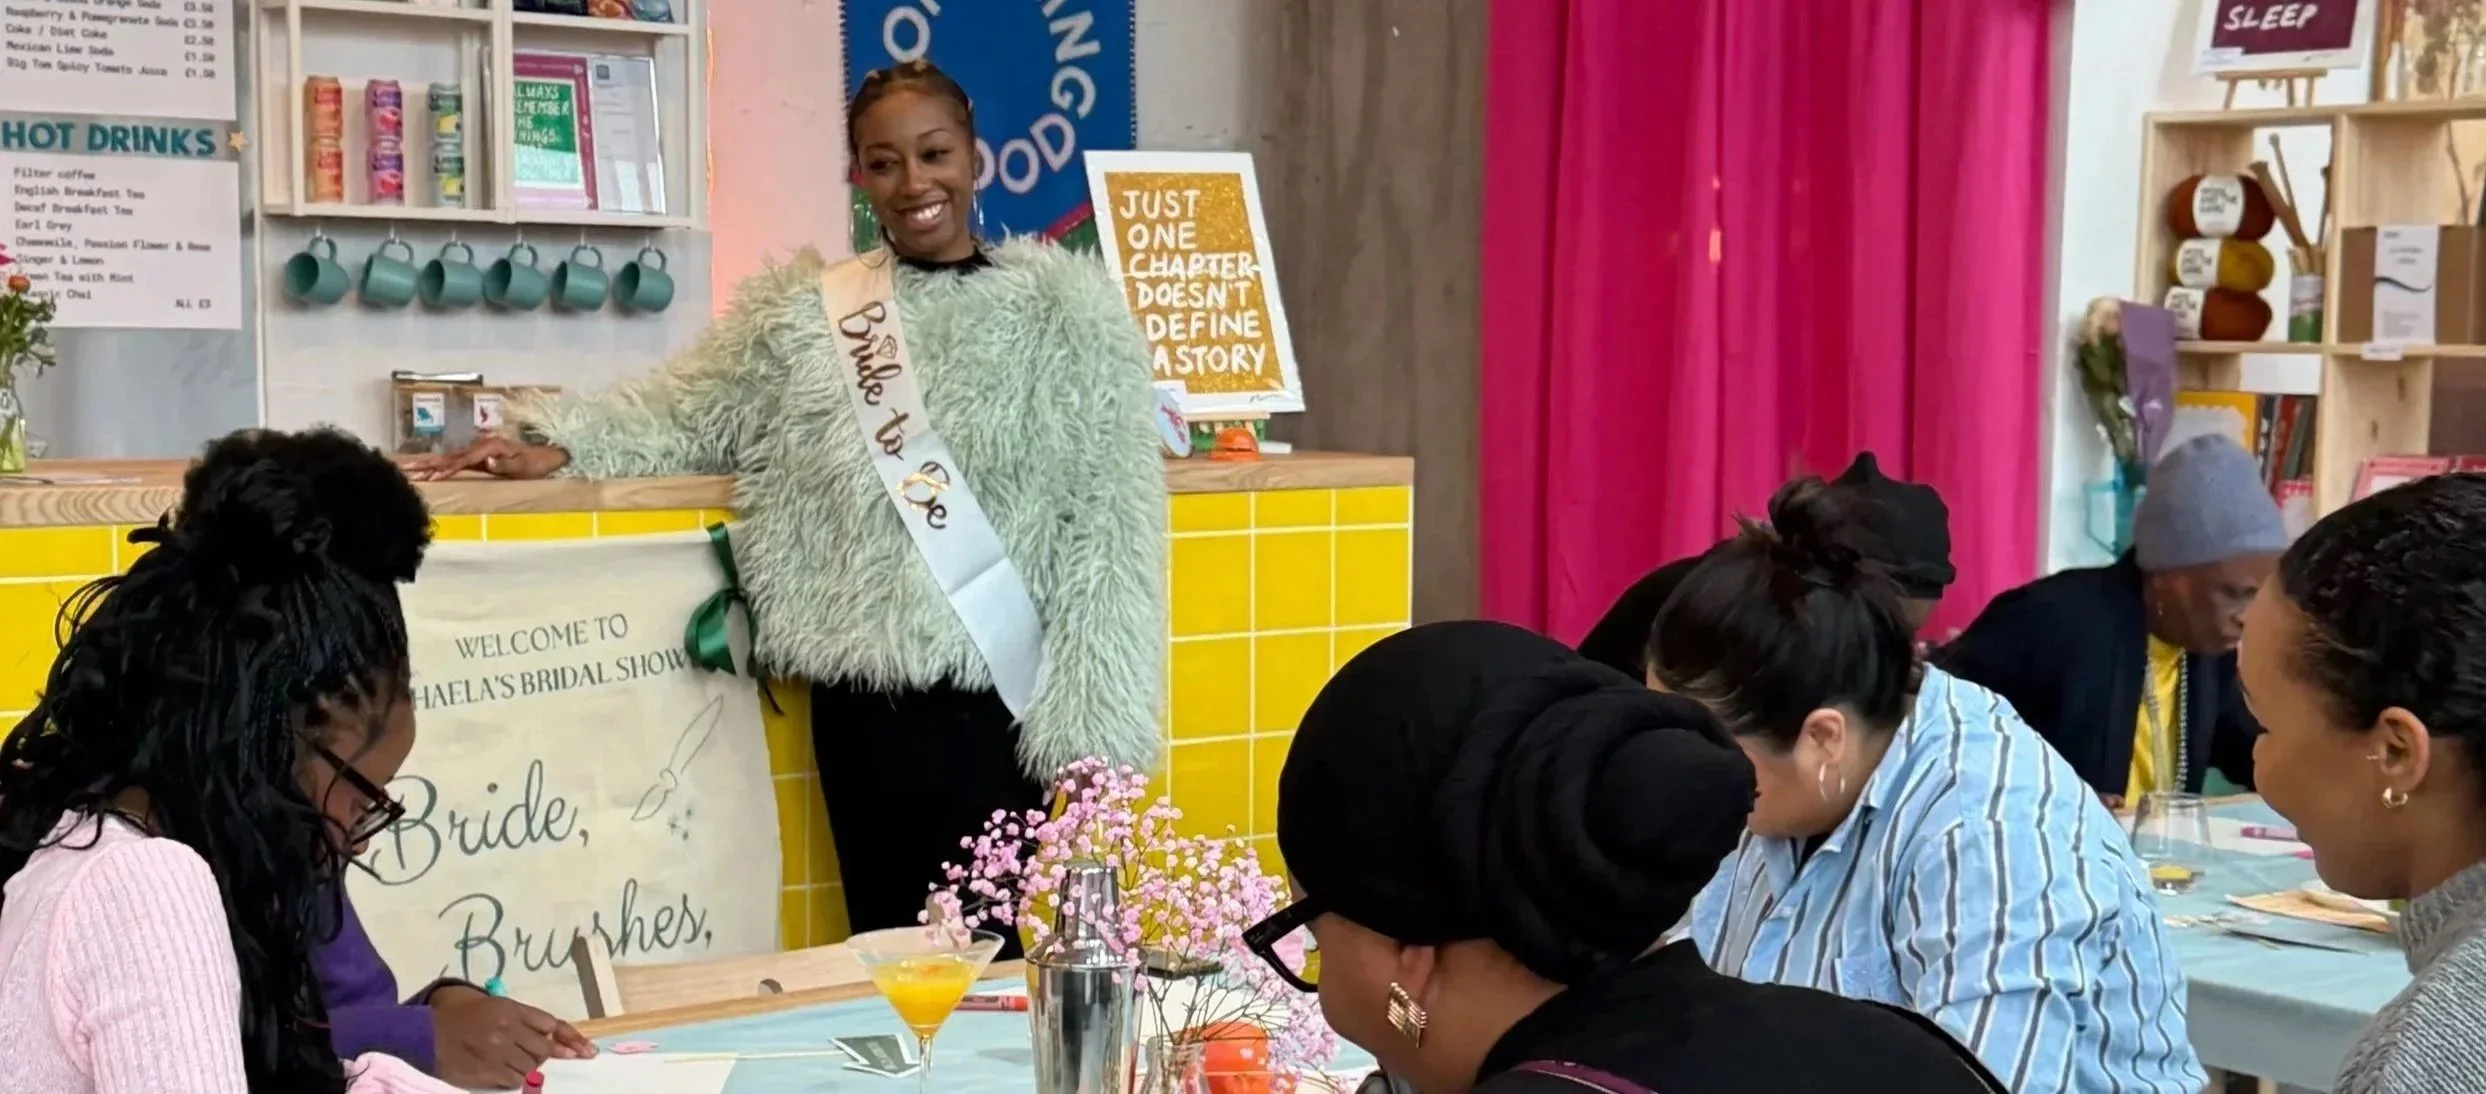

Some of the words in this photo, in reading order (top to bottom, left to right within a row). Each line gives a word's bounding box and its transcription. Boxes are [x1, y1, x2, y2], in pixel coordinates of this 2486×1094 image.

[6, 24, 32, 34] Coke
[81, 28, 108, 39] Coke
[2224, 4, 2318, 31] SLEEP
[515, 84, 560, 100] LWAYS
[515, 101, 570, 115] EMEMBER
[515, 116, 534, 129] HE
[3, 121, 75, 150] HOT
[88, 124, 216, 156] DRINKS
[14, 167, 52, 179] Filter
[57, 169, 96, 180] coffee
[14, 184, 59, 197] English
[64, 186, 119, 198] Breakfast
[126, 188, 146, 199] Tea
[1120, 188, 1201, 220] JUST
[14, 202, 46, 213] Decaf
[52, 203, 108, 215] Breakfast
[114, 205, 133, 216] Tea
[15, 219, 41, 231] Earl
[46, 220, 72, 233] Grey
[1127, 222, 1198, 251] ONE
[53, 271, 74, 282] Tea
[1129, 252, 1255, 281] CHAPTER
[1135, 280, 1253, 309] DOESN'T
[1145, 310, 1263, 342] DEFINE
[1152, 348, 1172, 377] A
[1175, 343, 1267, 377] STORY
[838, 301, 902, 407] Bride
[875, 408, 909, 462] to
[455, 620, 588, 659] WELCOME
[593, 612, 629, 642] TO
[411, 673, 515, 711] HAELA'S
[520, 661, 613, 697] BRIDAL
